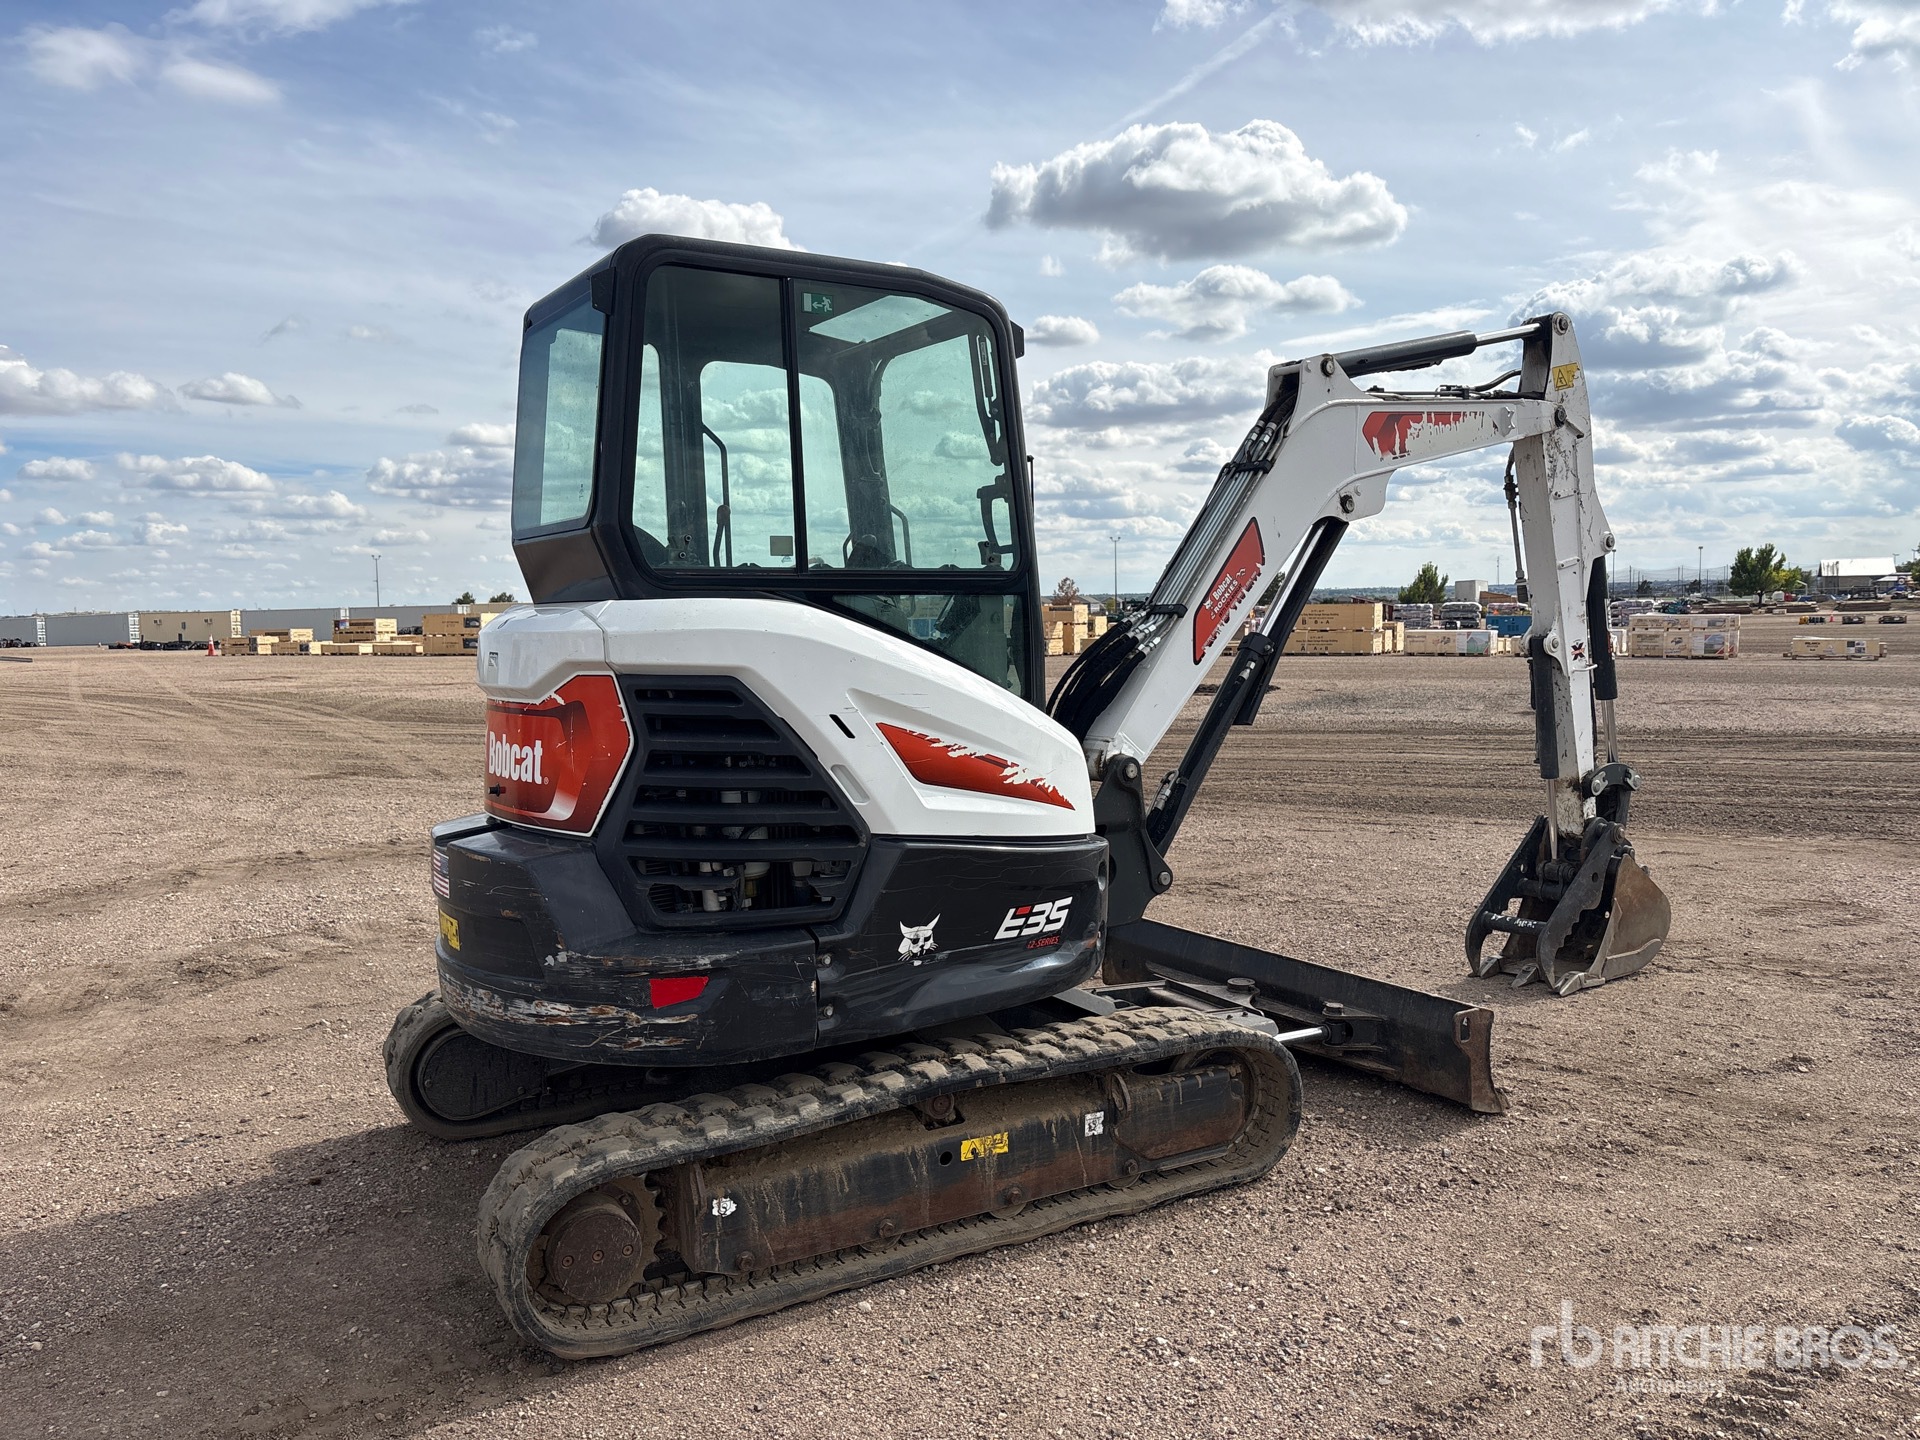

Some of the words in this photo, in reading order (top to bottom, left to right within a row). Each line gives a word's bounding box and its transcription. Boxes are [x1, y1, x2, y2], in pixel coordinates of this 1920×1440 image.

[1212, 573, 1233, 601] Bobcat
[1213, 579, 1239, 614] ROCKIES
[489, 731, 543, 785] Bobcat
[993, 896, 1073, 940] E35
